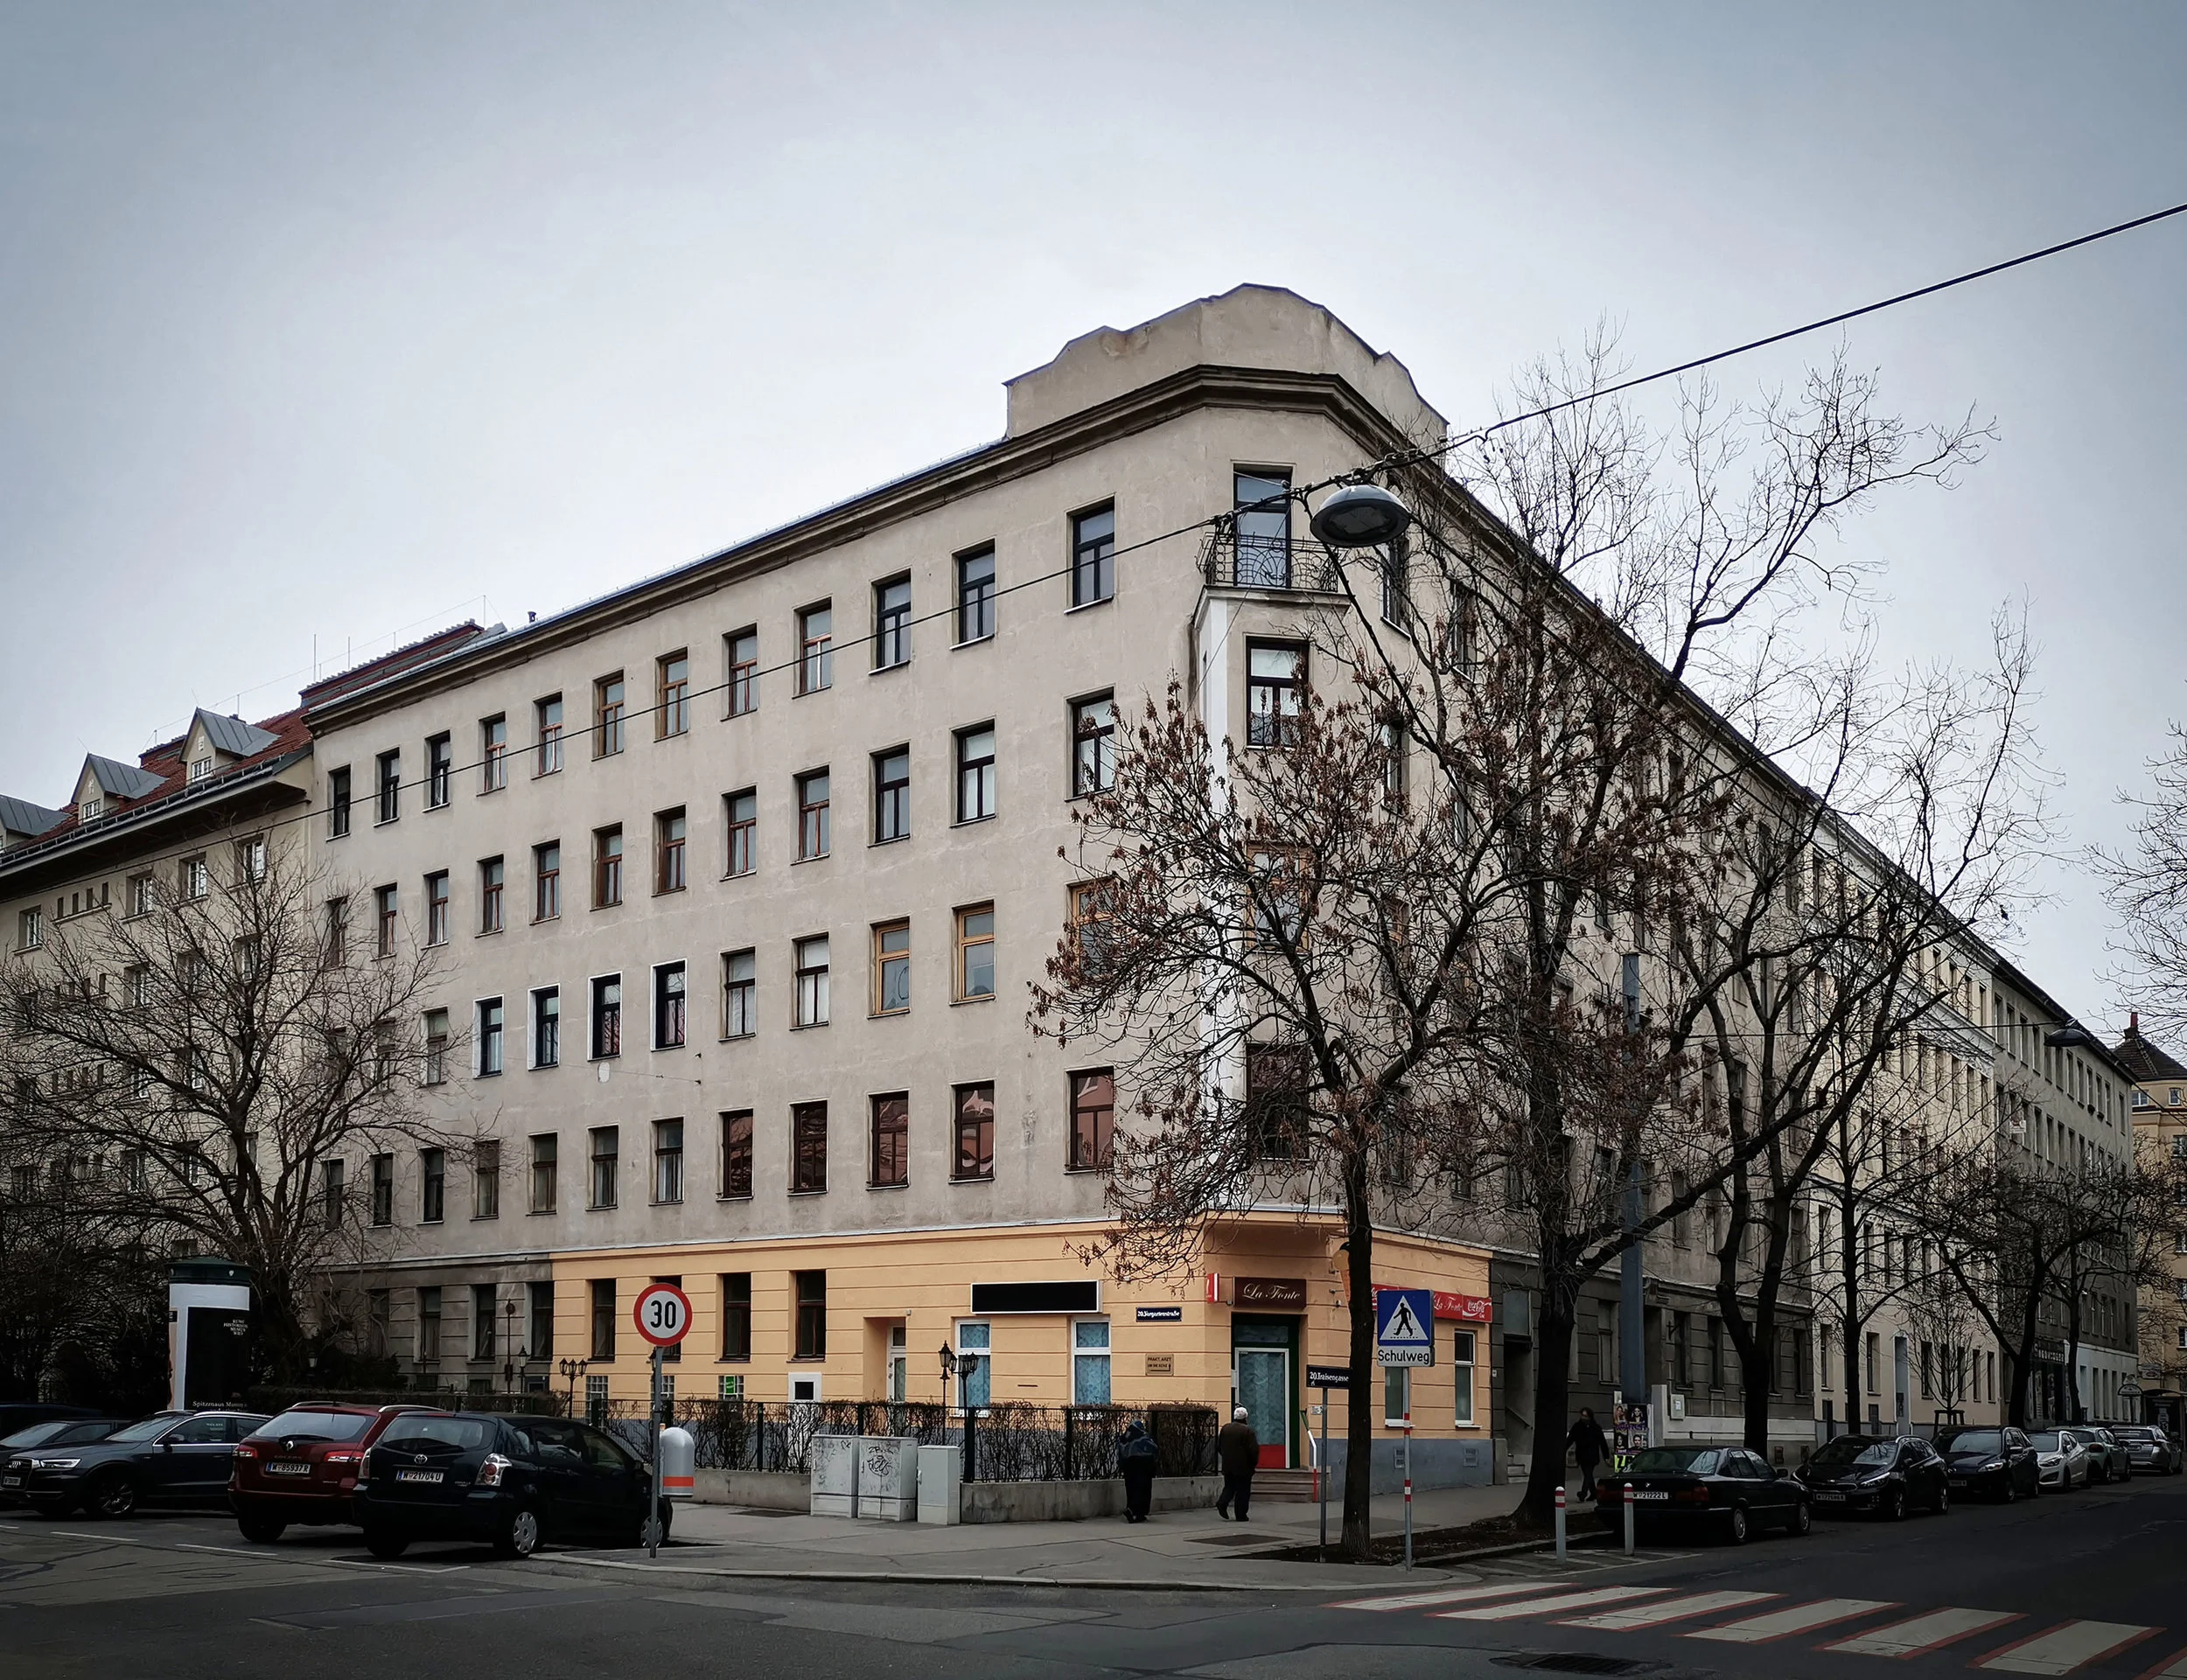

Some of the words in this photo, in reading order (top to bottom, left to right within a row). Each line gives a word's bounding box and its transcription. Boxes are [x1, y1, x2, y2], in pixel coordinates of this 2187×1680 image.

[1242, 1282, 1262, 1300] La
[650, 1300, 676, 1329] 30
[1378, 1349, 1429, 1365] Schulweg
